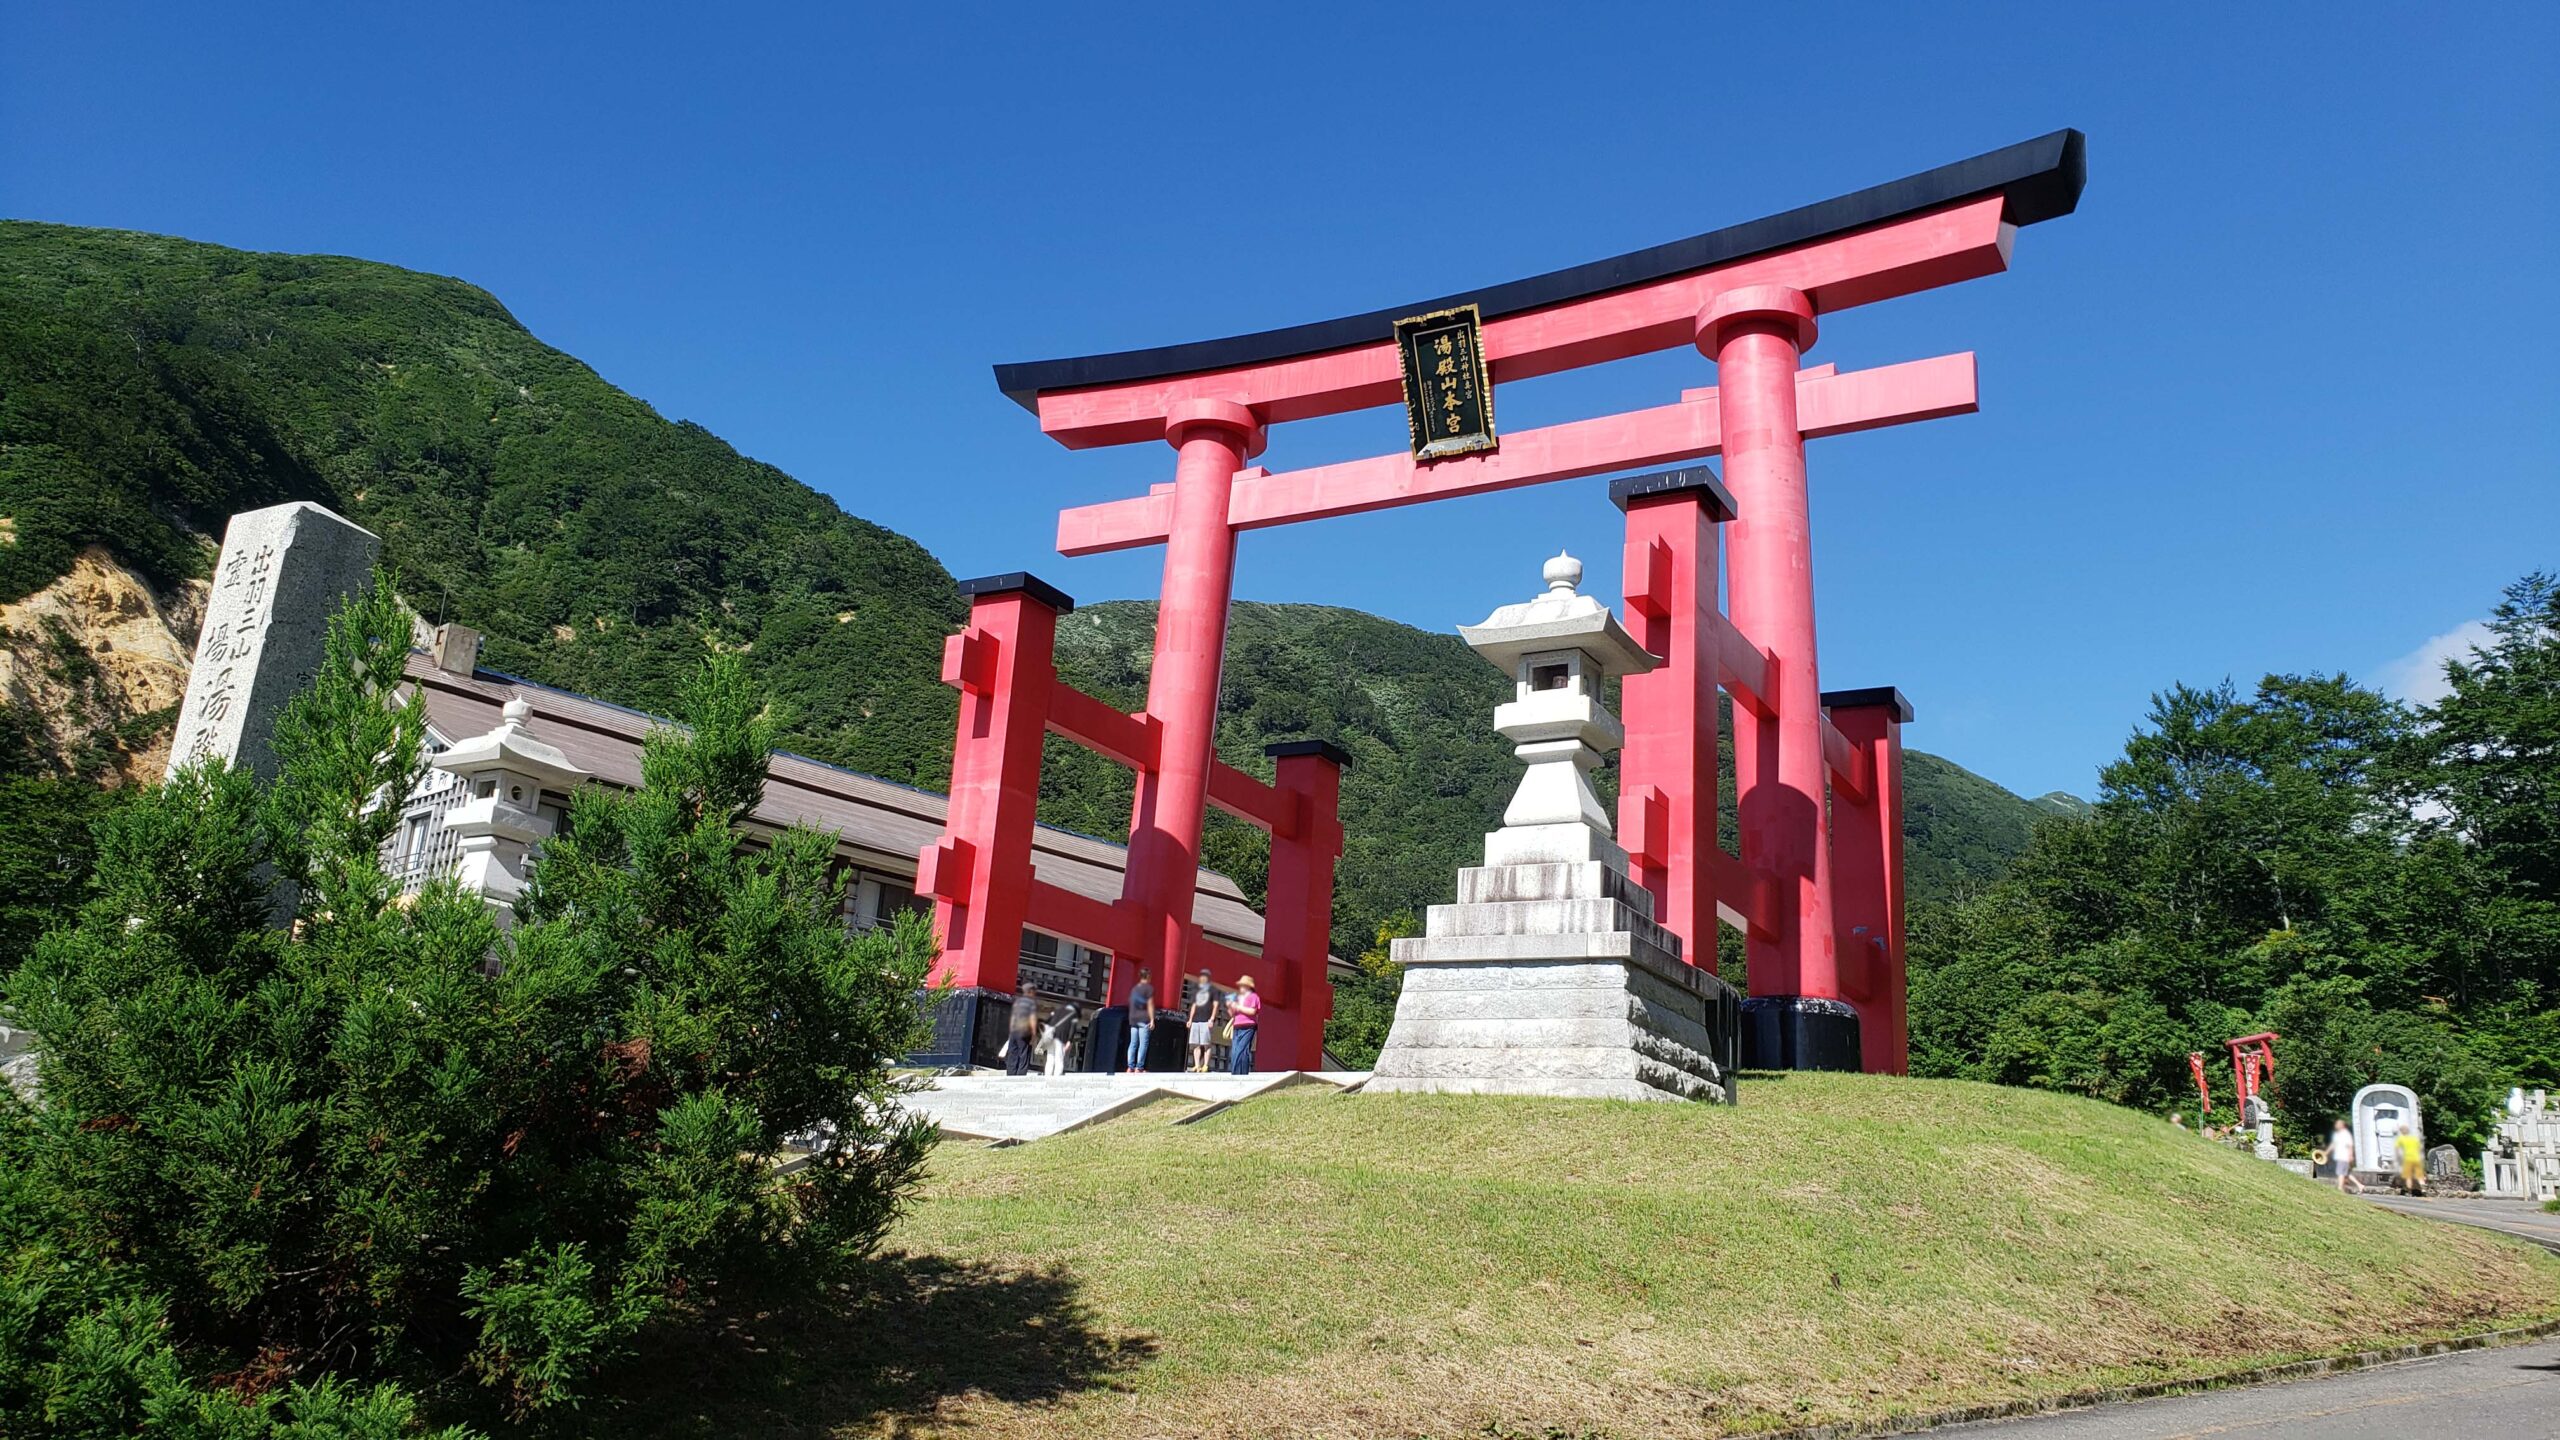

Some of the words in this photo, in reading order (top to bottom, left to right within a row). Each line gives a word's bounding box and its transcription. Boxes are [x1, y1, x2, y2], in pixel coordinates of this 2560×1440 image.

[1434, 334, 1463, 433] 湯殿山本宮
